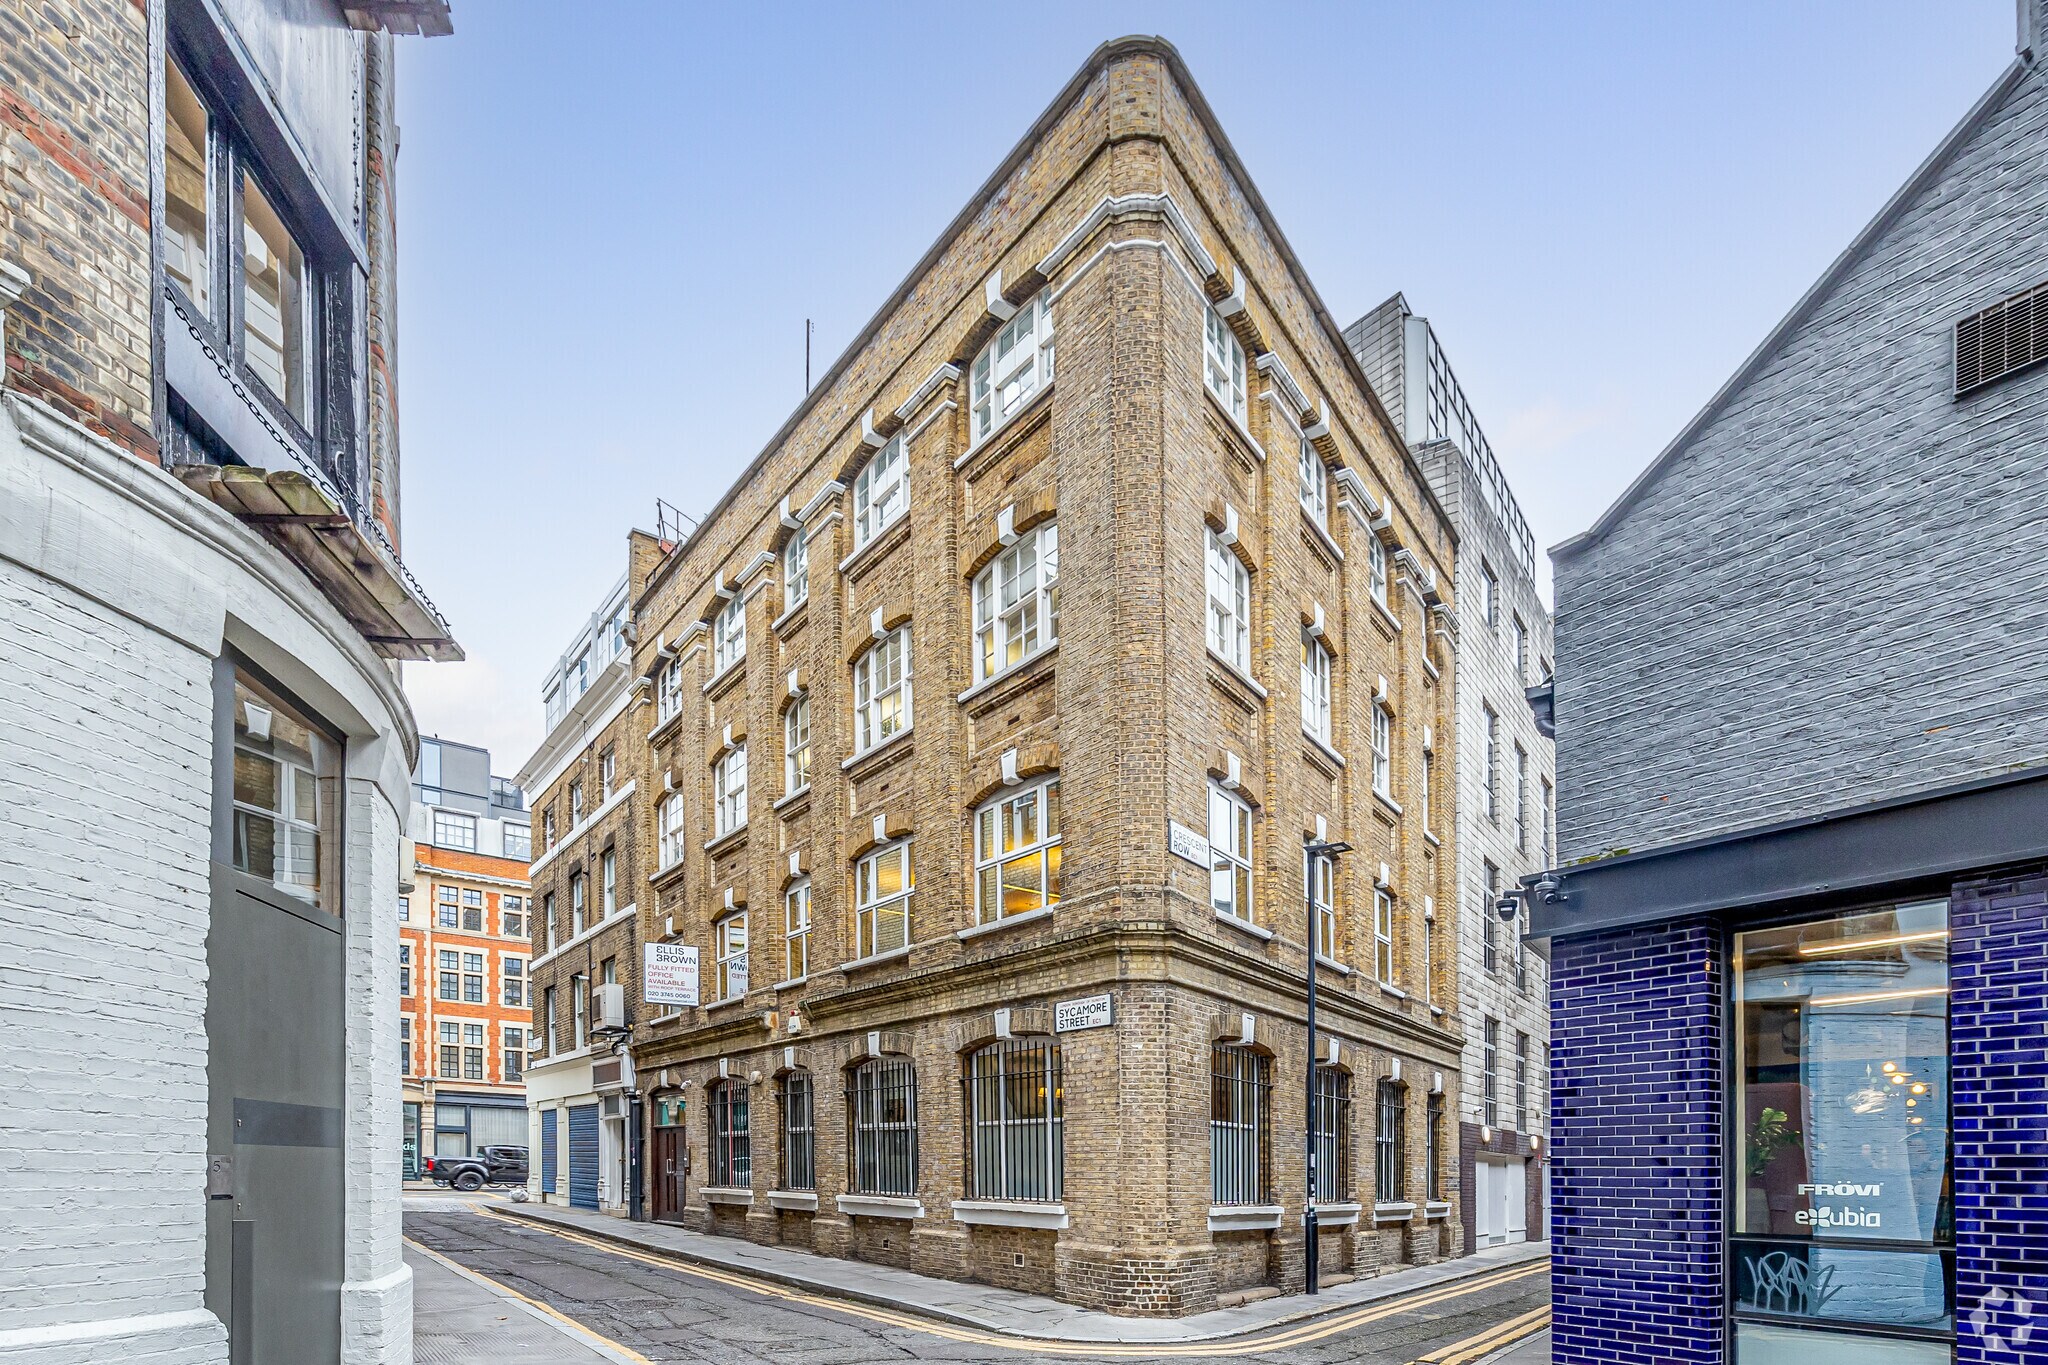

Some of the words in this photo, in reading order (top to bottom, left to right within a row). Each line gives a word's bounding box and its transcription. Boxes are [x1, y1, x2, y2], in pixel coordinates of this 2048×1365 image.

[1173, 830, 1207, 854] CRESCENT
[1173, 840, 1190, 856] ROW
[656, 945, 685, 956] ELLIS
[647, 971, 674, 979] OFFICE
[670, 966, 696, 974] FITTED
[647, 978, 686, 987] AVAILABLE
[1058, 1002, 1108, 1019] SYCAMORE
[1059, 1015, 1091, 1029] STREET
[1798, 1181, 1881, 1197] FRÖVI
